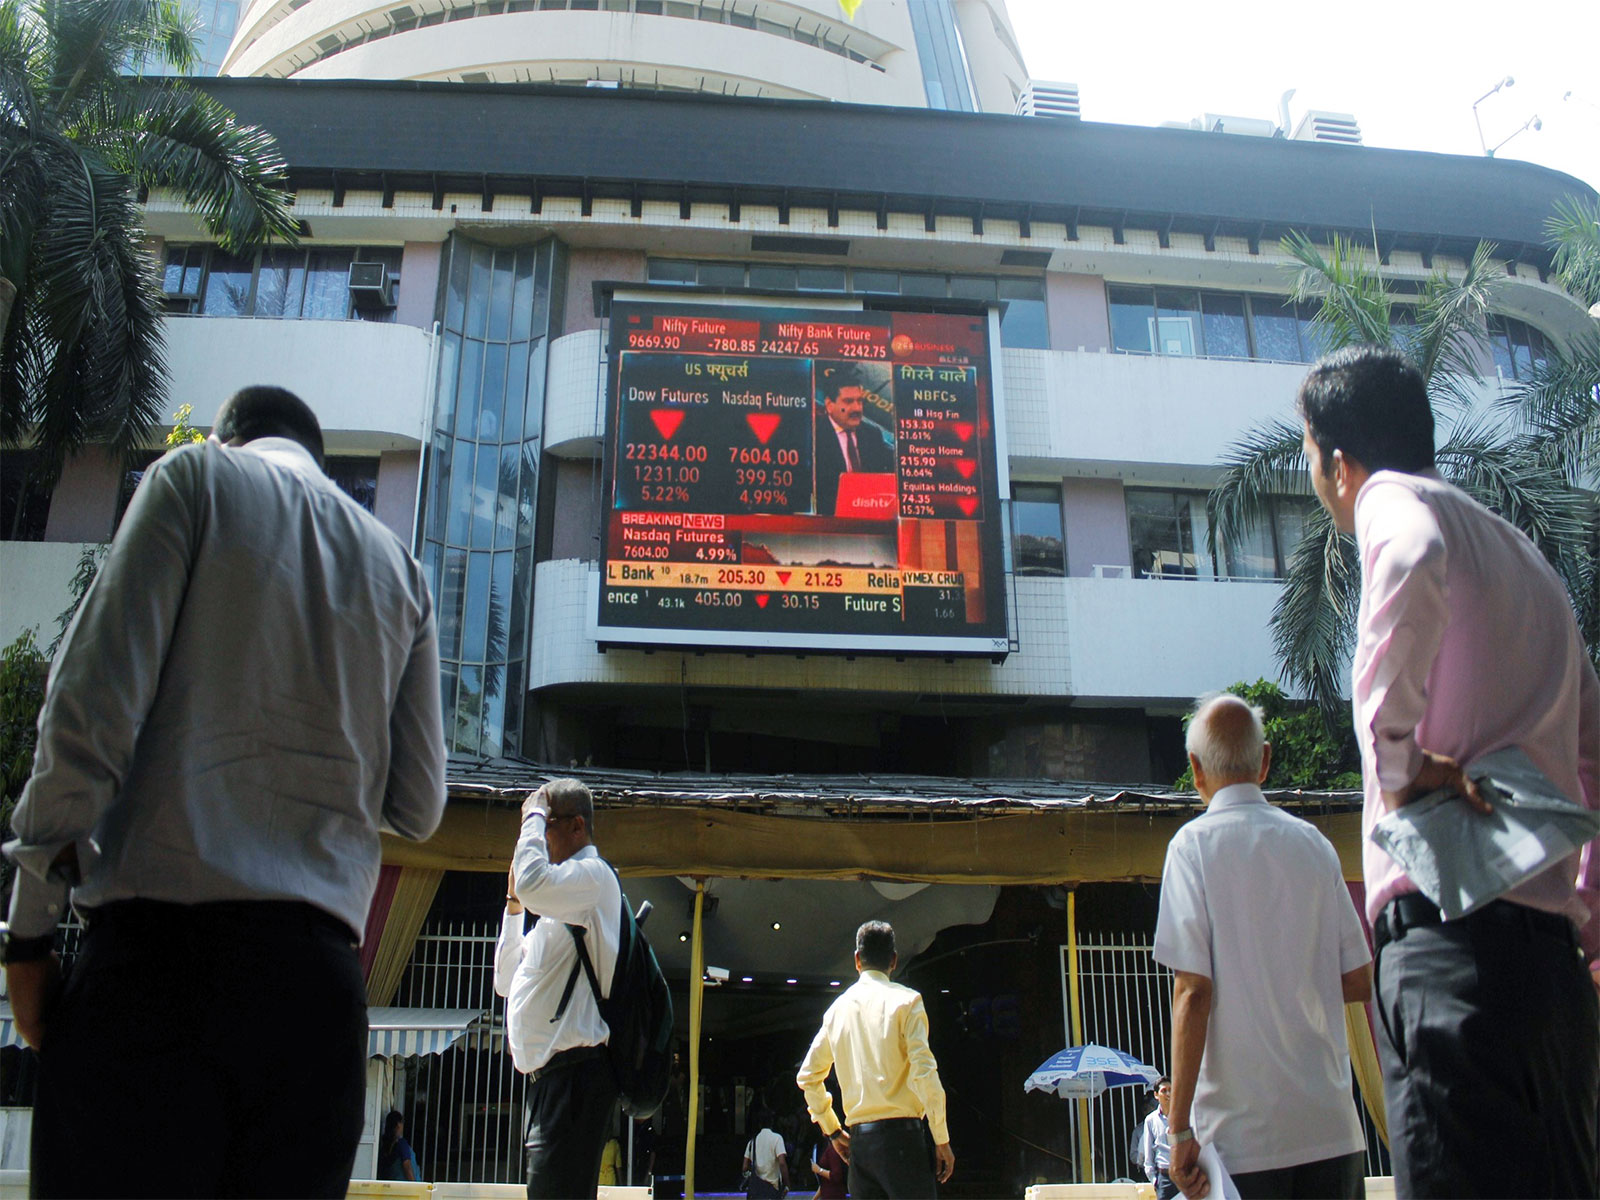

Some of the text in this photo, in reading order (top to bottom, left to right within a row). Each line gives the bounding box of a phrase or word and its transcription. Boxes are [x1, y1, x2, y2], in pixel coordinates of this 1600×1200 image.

[663, 319, 726, 335] Nifty Future
[778, 324, 871, 340] Nifty Bank Future
[629, 335, 755, 352] 9669.90 -780.85
[761, 341, 886, 358] 24247.65 -2242.75
[914, 342, 955, 352] BUSINESS
[685, 360, 748, 381] US फ्यूचर्स
[901, 365, 967, 382] गिरने वाले
[629, 387, 709, 404] Dow Futures
[722, 390, 807, 409] Nasdaq Futures
[914, 390, 957, 402] NBFCs
[926, 409, 943, 419] Hsg
[946, 410, 960, 419] Fin
[900, 420, 934, 430] 153.30
[899, 431, 931, 440] 21.61%
[626, 443, 708, 462] 22344.00
[729, 447, 799, 465] 7604.00
[909, 444, 964, 456] Repco Home
[900, 456, 936, 466] 215.90
[635, 465, 700, 484] 1231.00
[736, 469, 793, 487] 399.50
[901, 467, 933, 477] 16.64%
[642, 486, 689, 502] 5.22%
[903, 481, 977, 495] Equitas Holdings
[739, 490, 788, 506] 4.99%
[852, 494, 895, 508] dishtv
[902, 494, 931, 504] 74.35
[622, 513, 723, 528] BREAKING NEWS
[623, 529, 724, 544] Nasdaq Futures
[624, 546, 737, 561] 7604.00 4.99%
[609, 566, 899, 588] L Bank 10 18.7m 205.30 21.25 Relia
[608, 590, 638, 604] ence
[658, 598, 685, 608] 43.1k
[695, 592, 742, 607] 405.00
[782, 595, 820, 609] 30.15
[845, 596, 887, 612] Future
[893, 597, 901, 612] S
